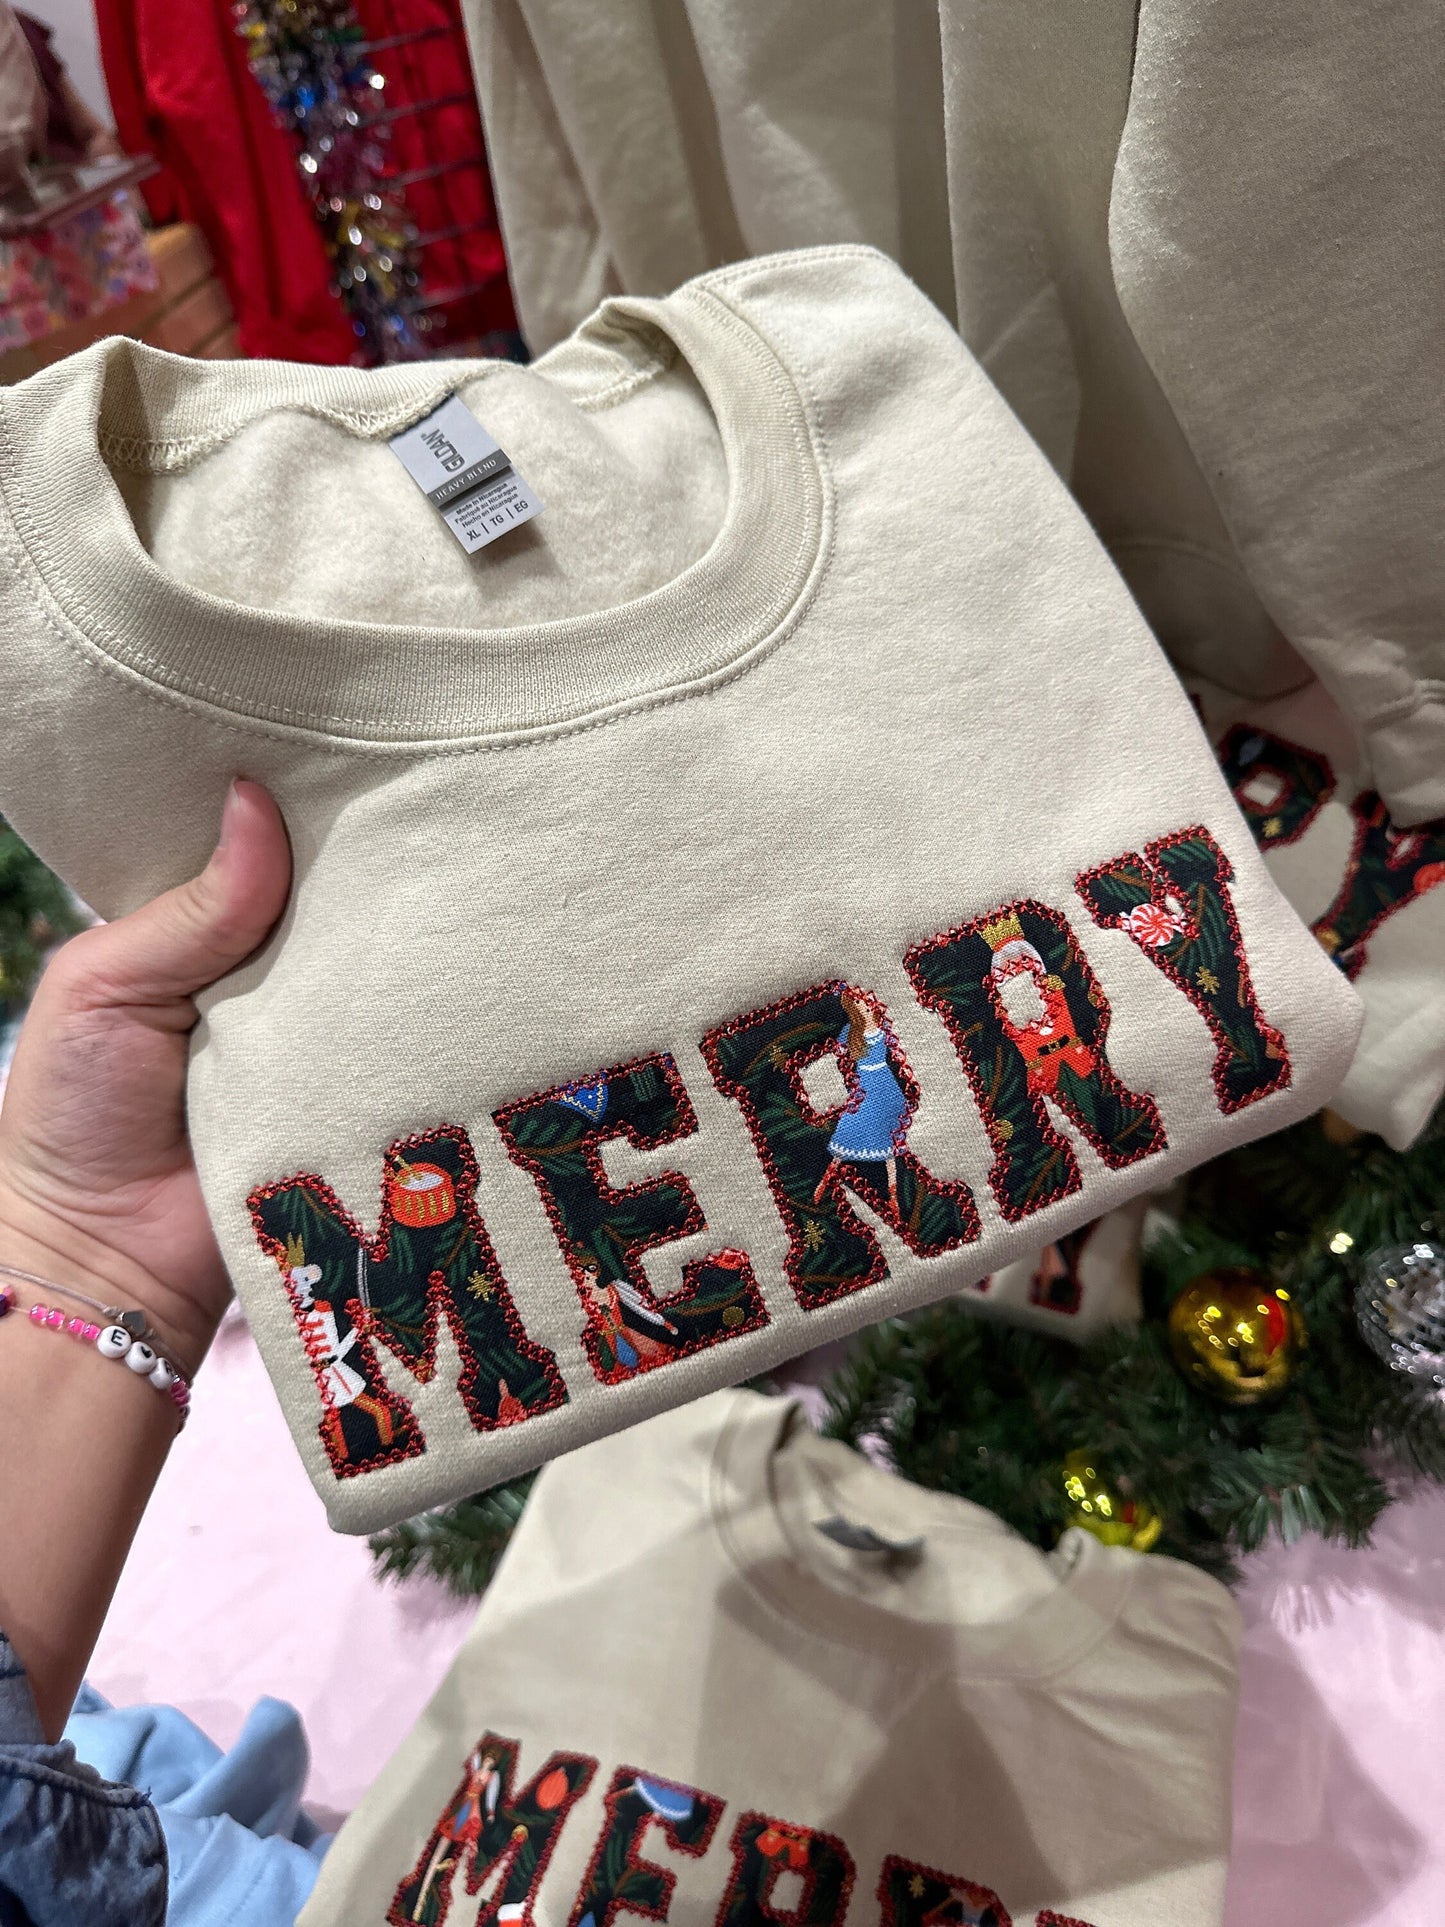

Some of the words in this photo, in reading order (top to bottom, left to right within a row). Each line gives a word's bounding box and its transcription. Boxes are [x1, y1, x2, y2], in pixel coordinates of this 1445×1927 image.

[422, 429, 466, 473] GILDAN
[435, 477, 465, 500] HEAVY
[466, 459, 497, 481] BLEND
[456, 503, 473, 515] Made
[478, 483, 508, 502] Nicaragua
[488, 486, 518, 505] Nicaragua
[461, 514, 482, 528] Hecho
[489, 493, 519, 513] Nicaragua
[466, 529, 481, 541] XL
[490, 514, 504, 527] TG
[513, 500, 529, 513] EG
[245, 824, 1292, 1480] MERRY
[110, 1328, 126, 1347] E
[385, 1729, 1096, 1927] MER
